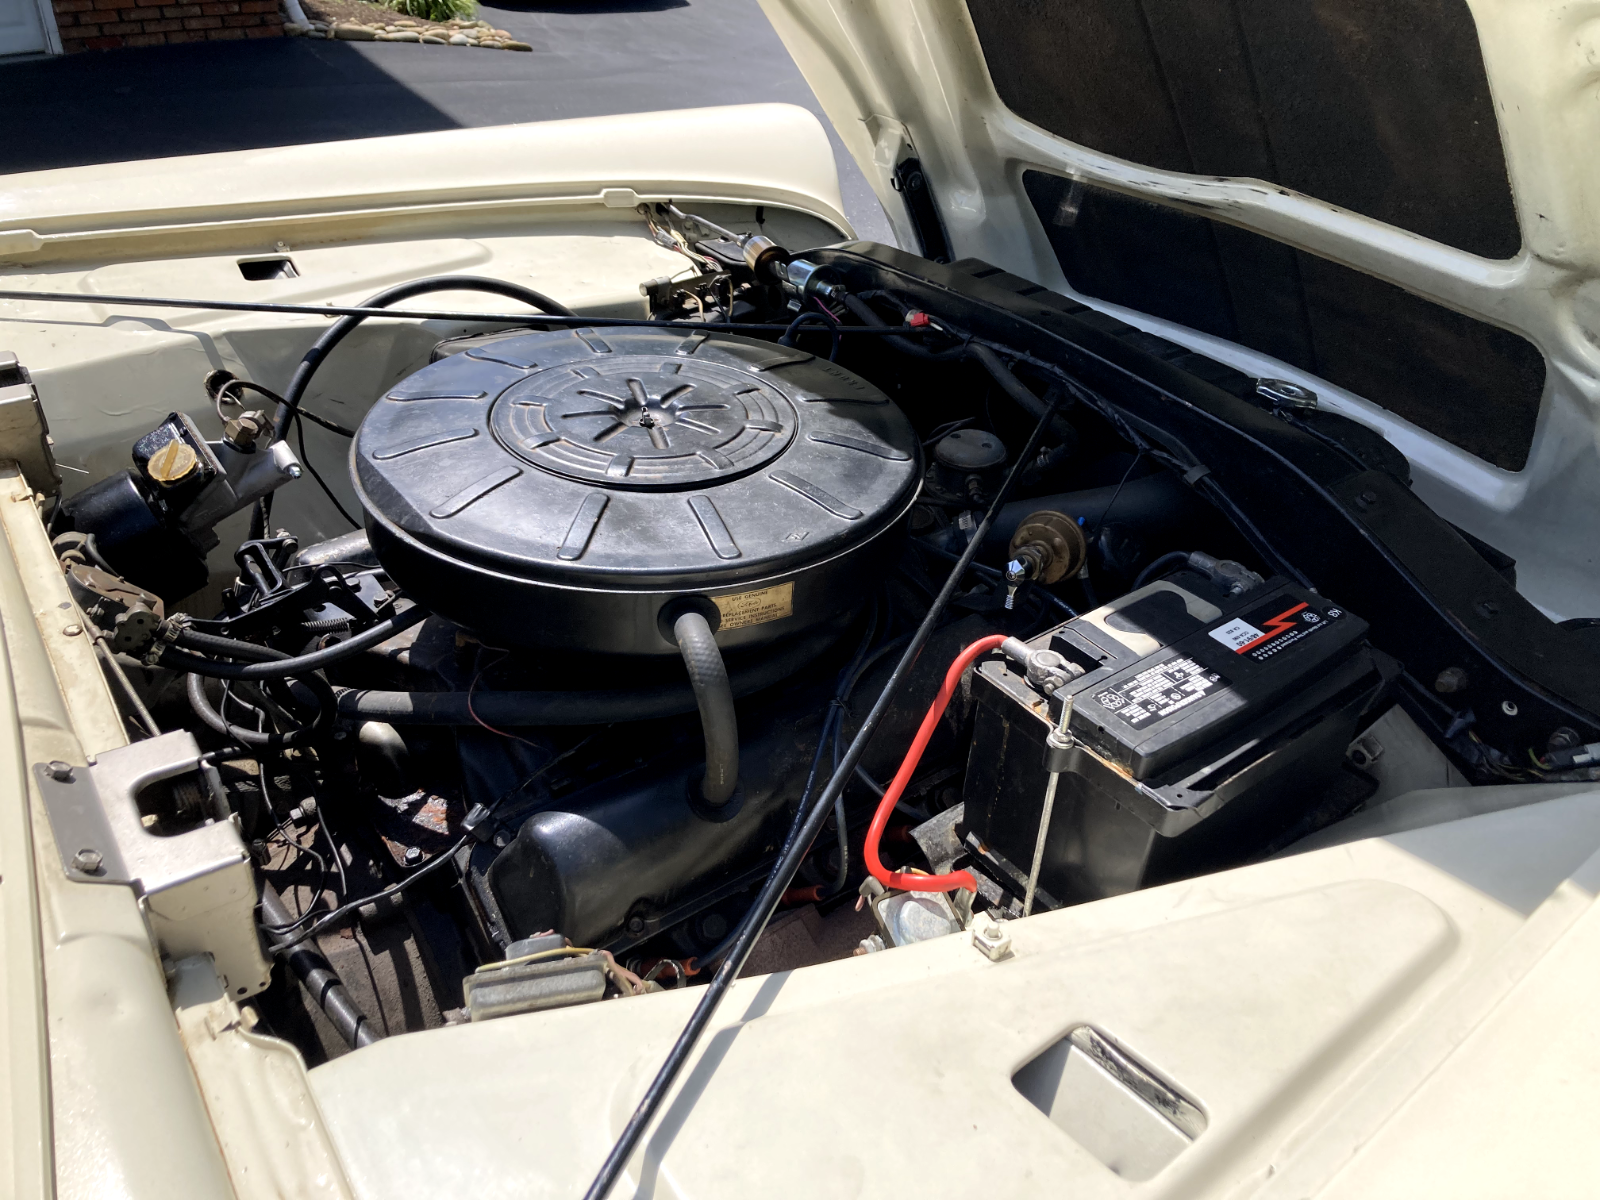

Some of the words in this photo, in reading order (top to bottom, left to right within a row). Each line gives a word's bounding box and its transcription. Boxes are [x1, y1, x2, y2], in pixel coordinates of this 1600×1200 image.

[744, 591, 768, 600] GENUINE
[722, 608, 759, 617] REPLACEMENT
[748, 606, 785, 618] INSTRUCTIONS
